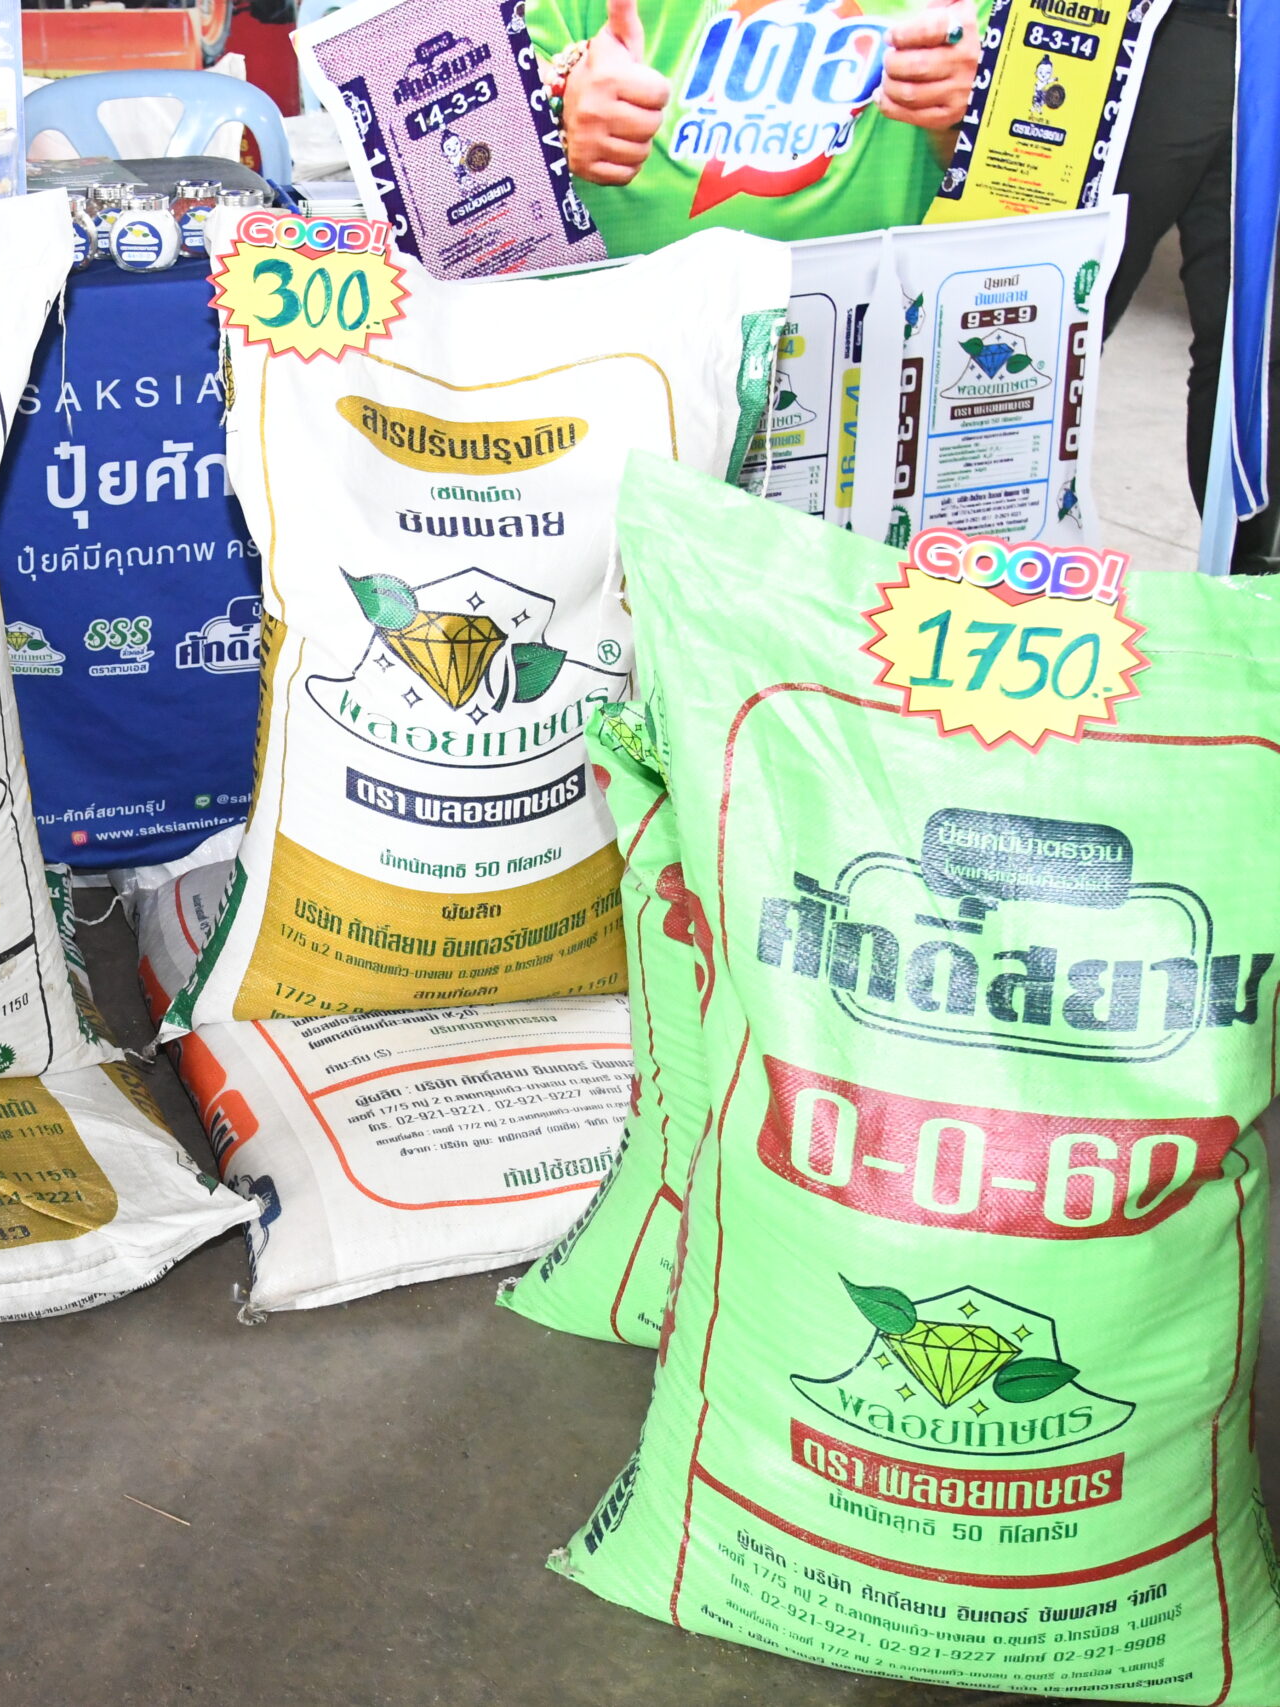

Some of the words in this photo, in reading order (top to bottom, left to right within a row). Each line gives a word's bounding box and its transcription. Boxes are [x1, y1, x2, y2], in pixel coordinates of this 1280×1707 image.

[1029, 26, 1093, 56] 8-3-14
[415, 81, 491, 132] 14-3-3
[238, 213, 391, 253] GOOD!
[967, 308, 1030, 327] 9-3-9
[20, 372, 223, 414] SAKSIA
[363, 405, 575, 466] สารปรับปรุงดิน
[46, 440, 233, 529] ปุ๋ยศัก
[18, 539, 216, 582] ปุ๋ยดีมีคุณภาพ
[913, 533, 1130, 604] GOOD!
[88, 617, 151, 648] SSS
[11, 666, 60, 675] ลอยเกษตร
[91, 665, 147, 676] ตราสามเอส
[339, 687, 609, 757] พลอยเกษตร
[34, 800, 166, 826] าม-ศักดิ์สยามกรุ๊ป
[357, 777, 406, 813] ตรา
[414, 774, 580, 824] พลอยเกษตร
[96, 817, 247, 841] www.saksiaminter.
[380, 849, 466, 879] น้ำหนักสุทธิ
[476, 862, 500, 878] 50
[507, 846, 562, 874] กิโลกรัม
[281, 924, 307, 947] 17/5
[295, 898, 342, 934] บริษัท
[348, 921, 436, 957] ศักดิ์สยาม
[758, 872, 1274, 1033] ศักดิ์สยาม
[274, 982, 317, 1006] 17/2
[373, 1048, 392, 1062] (S)
[355, 1086, 402, 1109] ผู้ผลิต
[415, 1077, 458, 1094] บริษัท
[461, 1068, 529, 1086] ศักดิ์สยาม
[533, 1060, 588, 1075] อินเตอร์
[497, 1089, 581, 1110] 02-921-9227
[379, 1103, 409, 1117] 17/5
[434, 1096, 441, 1105] 2
[20, 1124, 64, 1139] 11150
[17, 1168, 77, 1183] 11150
[790, 1088, 1197, 1228] 0-0-60
[839, 1386, 1093, 1448] พลอยเกษตร
[802, 1436, 866, 1483] ตรา
[879, 1462, 1112, 1513] พลอยเกษตร
[829, 1489, 936, 1537] น้ำหนักสุทธิ
[952, 1522, 983, 1543] 50
[998, 1520, 1079, 1544] กิโลกรัม
[737, 1529, 787, 1568] ผู้ผลิต
[804, 1566, 852, 1594] บริษัท
[862, 1583, 946, 1619] ศักดิ์สยาม
[957, 1606, 1029, 1624] อินเตอร์
[1127, 1583, 1167, 1607] จำกัด
[753, 1562, 787, 1589] 17/5
[819, 1594, 828, 1607] 2
[821, 1641, 849, 1658] 17/2
[879, 1637, 996, 1662] 02-921-9227
[1054, 1633, 1166, 1662] 02-921-9908
